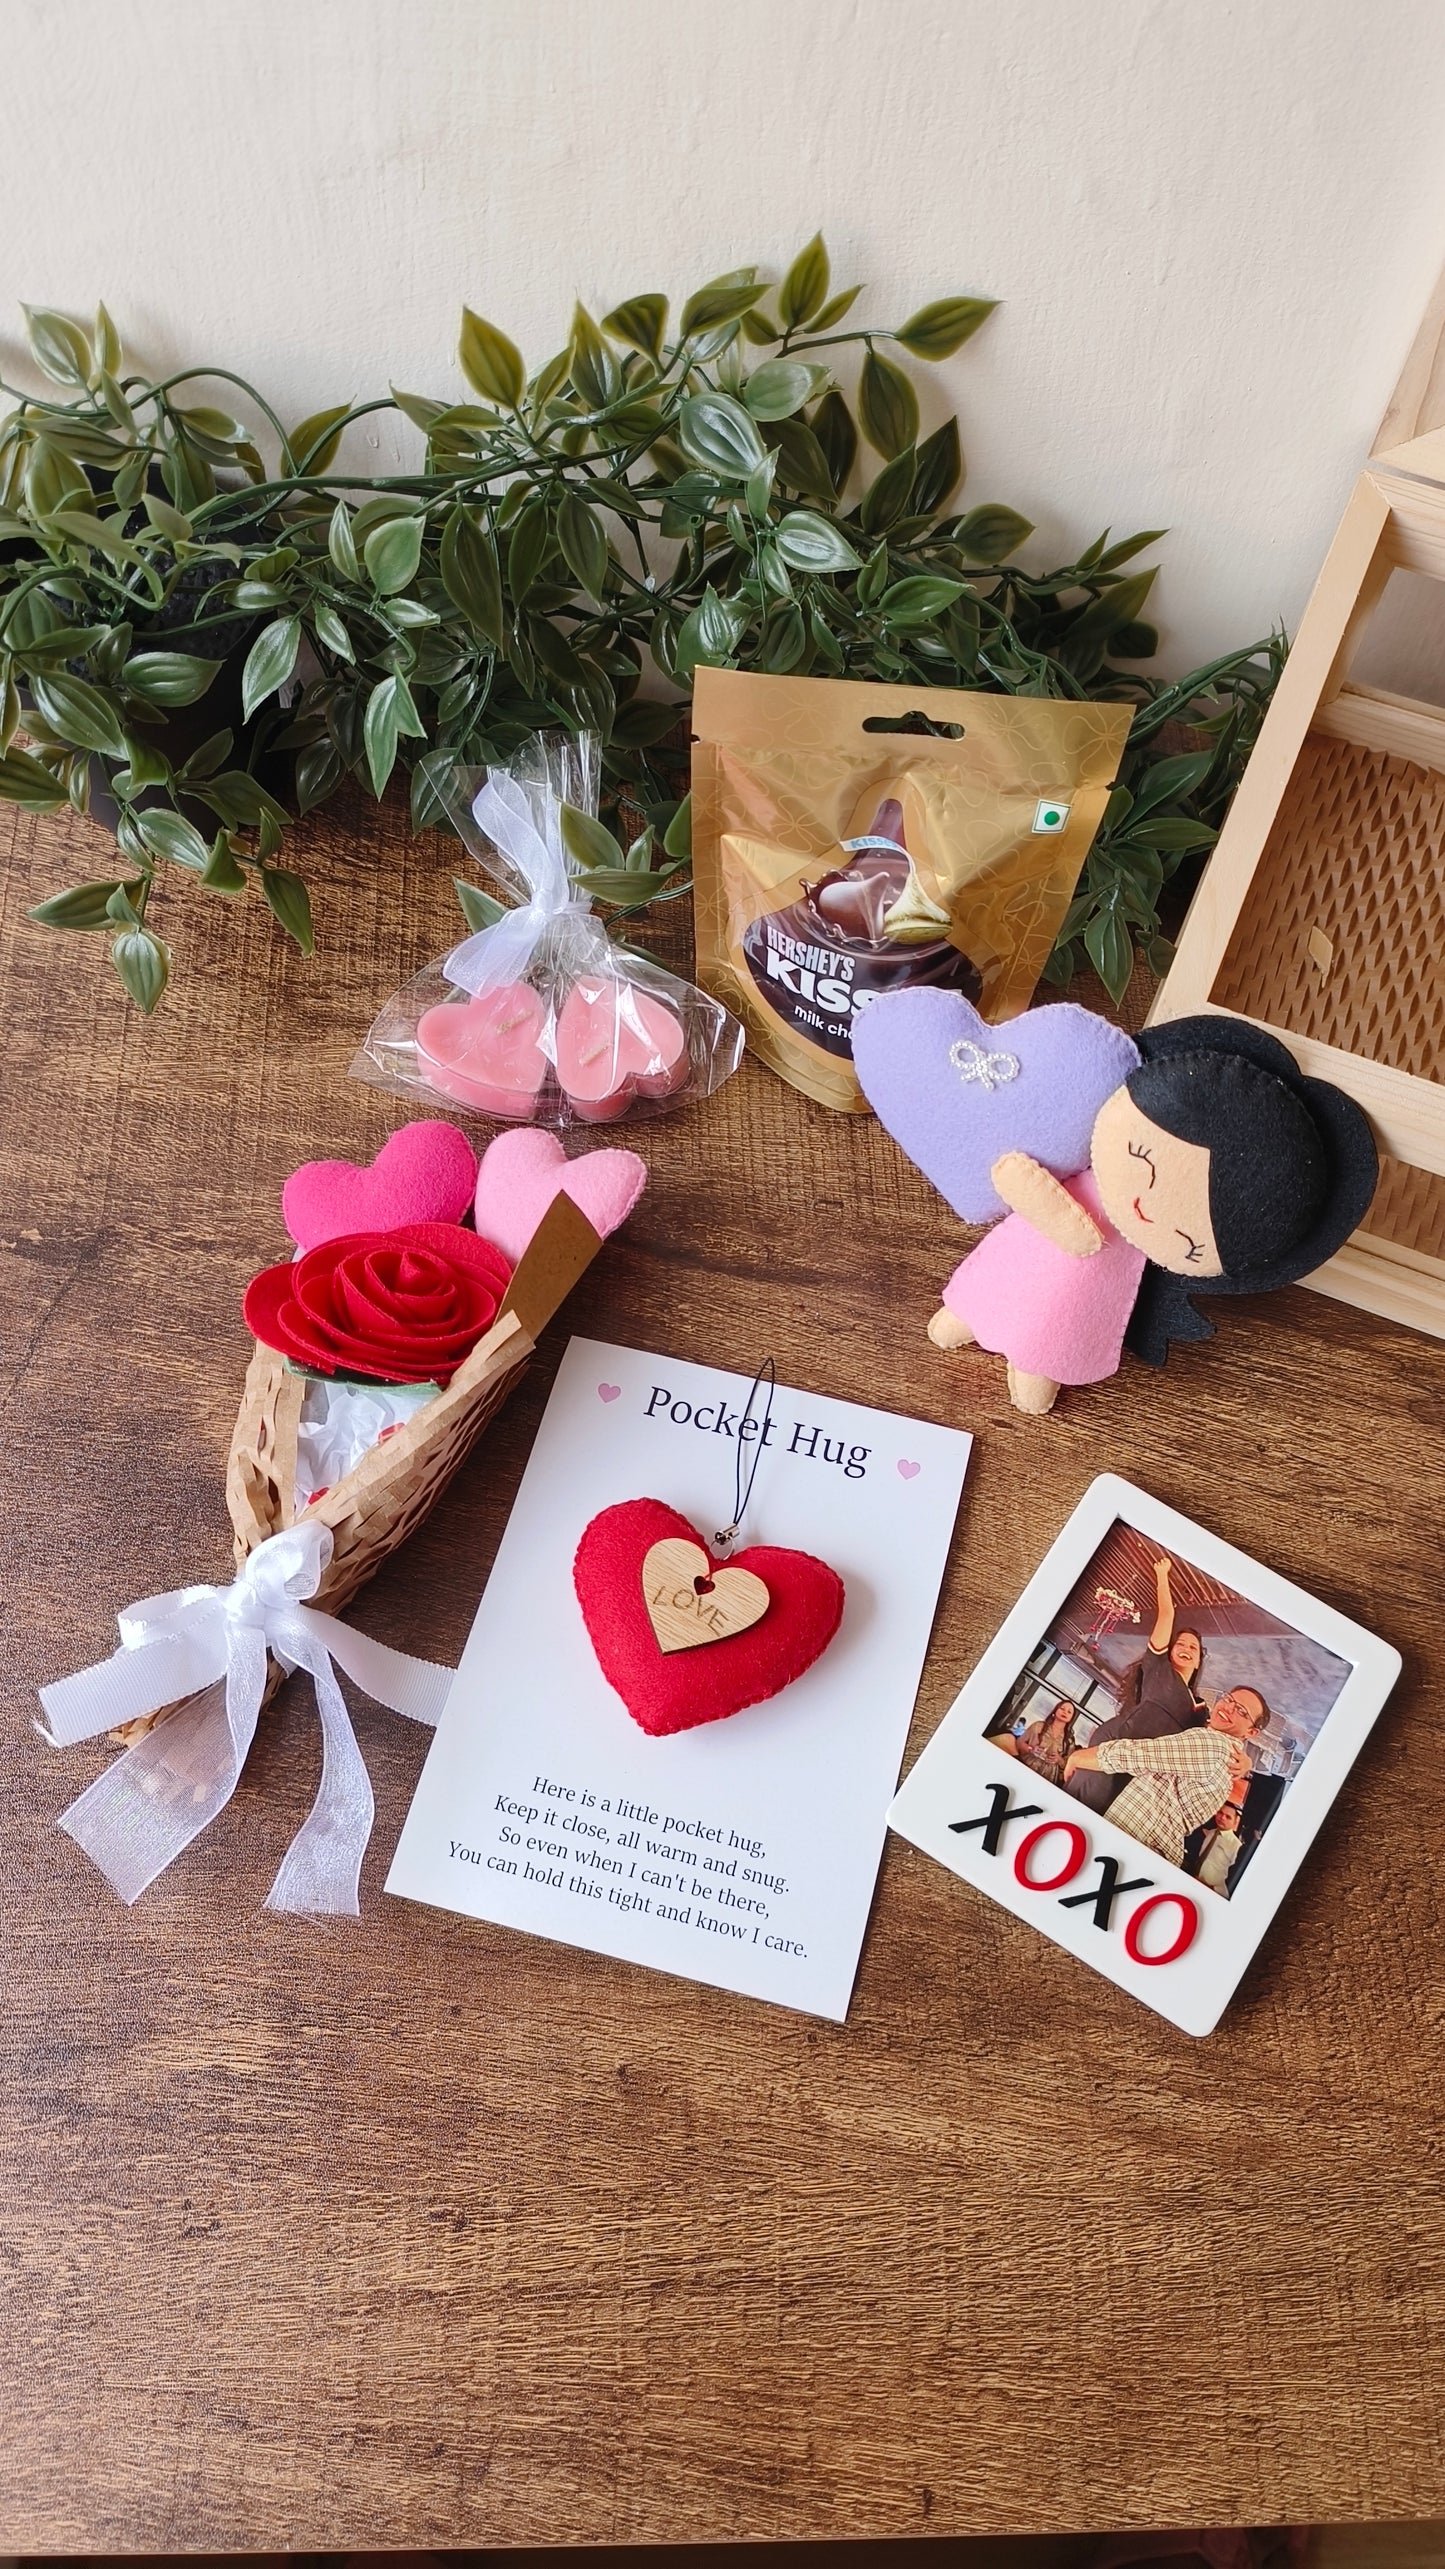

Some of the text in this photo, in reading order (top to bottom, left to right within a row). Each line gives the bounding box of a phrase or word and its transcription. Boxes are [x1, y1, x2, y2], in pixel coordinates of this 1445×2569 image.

[766, 925, 855, 983] HERSHEY'S
[794, 1004, 824, 1031] milk
[643, 1385, 873, 1480] Pocket Hug
[651, 1584, 731, 1638] LOVE
[494, 1795, 790, 1894] Keep it close, all warm and snug.
[532, 1776, 766, 1859] Here is a little pocket hug,
[448, 1841, 808, 1959] You can hold this tight and know I care.
[498, 1826, 770, 1920] So even when I can't be there,
[947, 1782, 1201, 1967] XOXO
